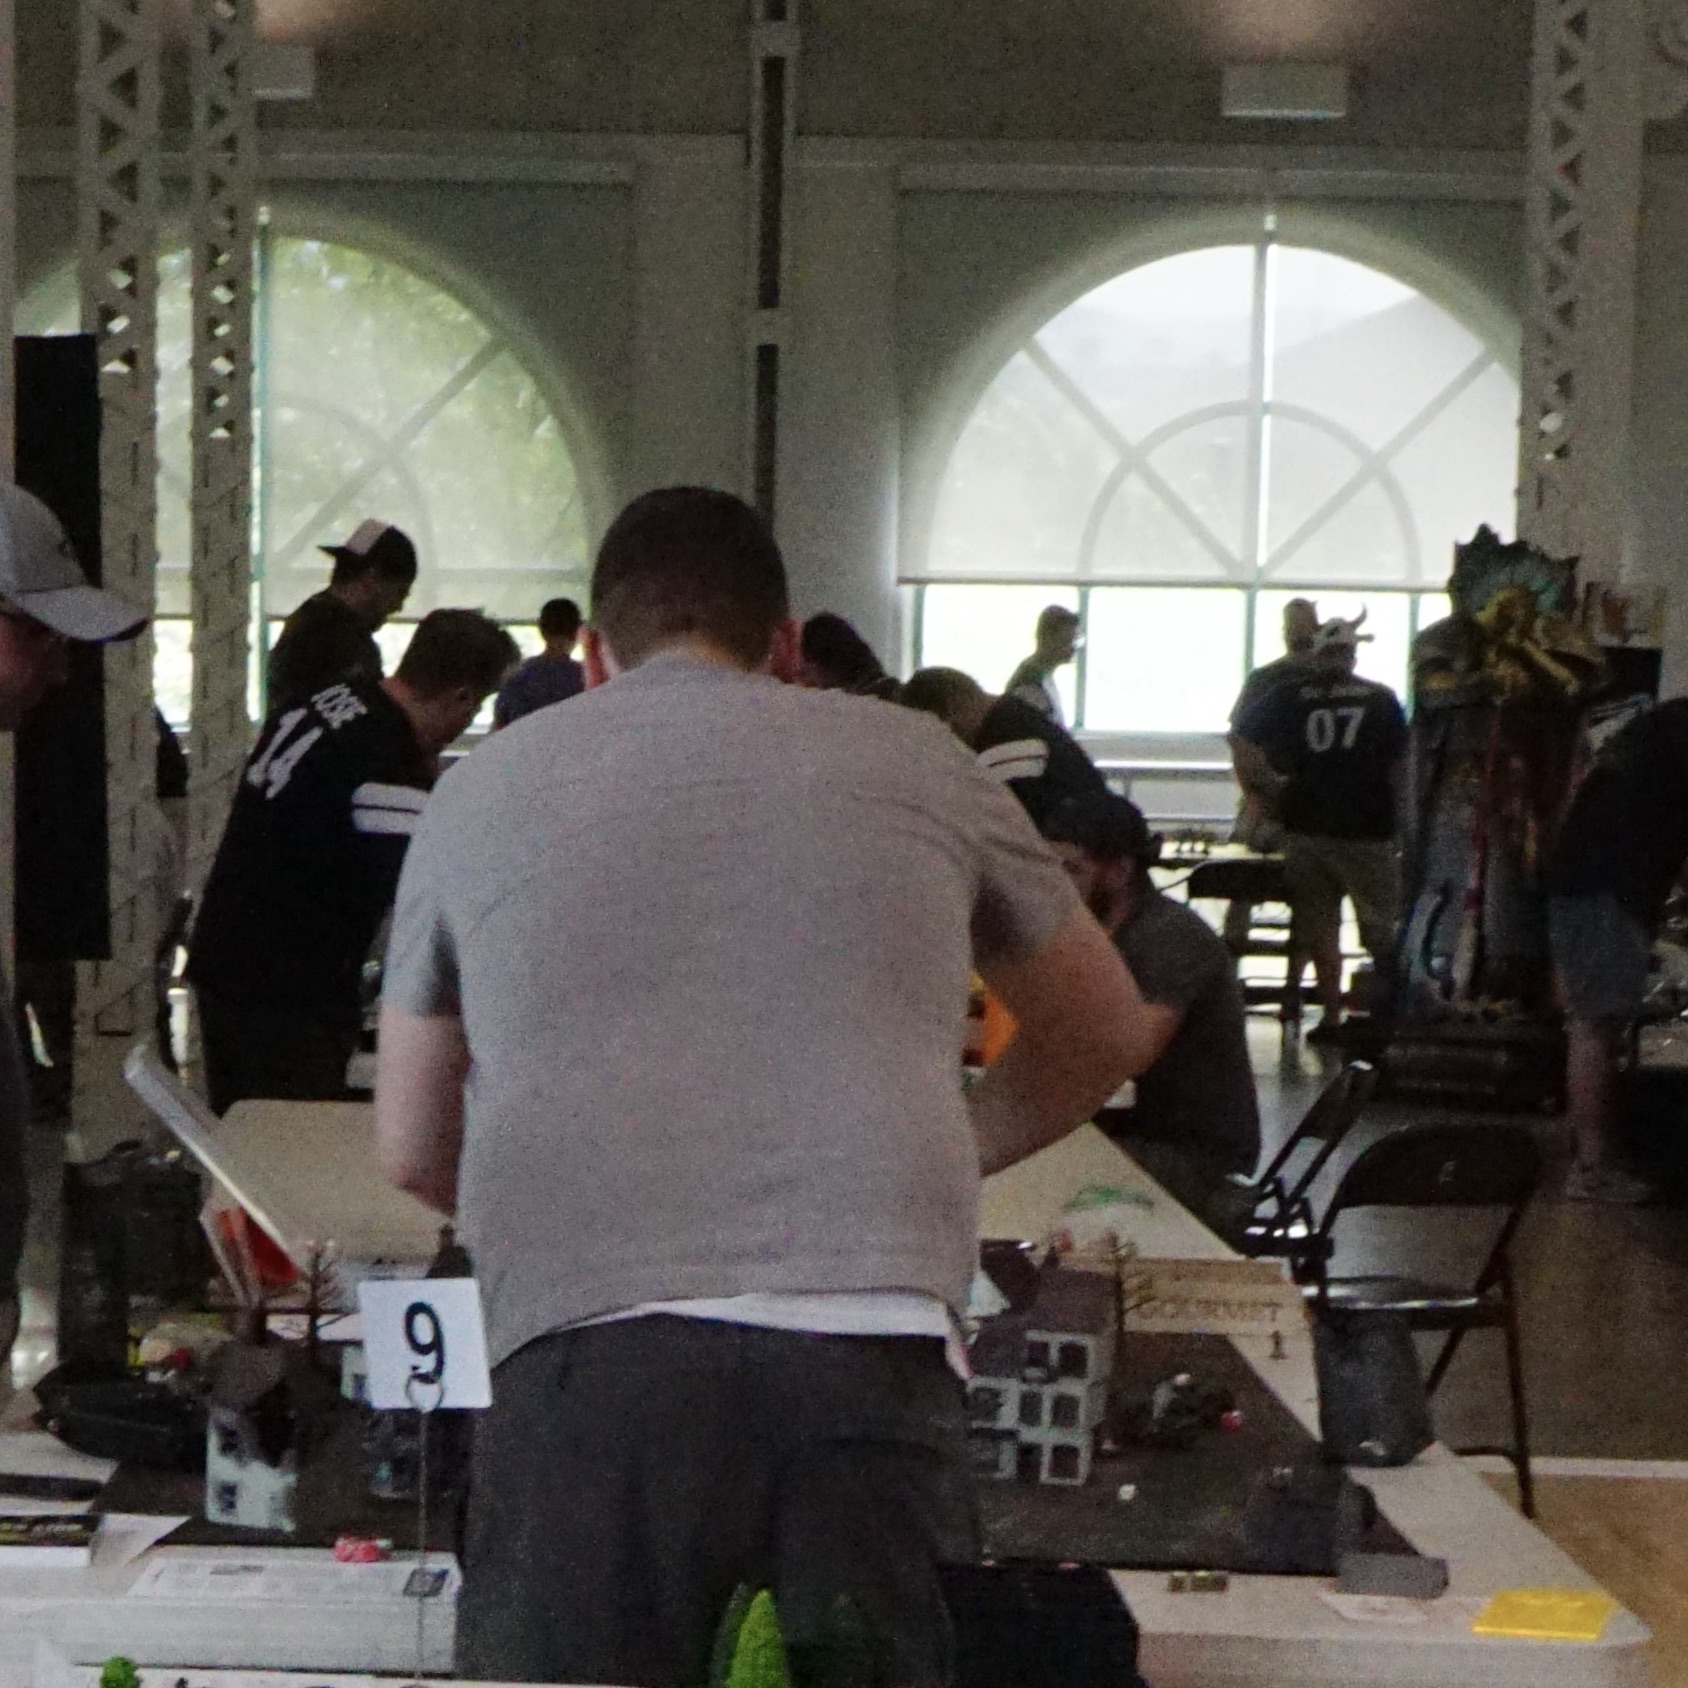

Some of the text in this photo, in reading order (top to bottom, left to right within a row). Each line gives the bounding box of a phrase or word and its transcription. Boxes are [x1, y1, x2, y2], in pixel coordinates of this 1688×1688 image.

[246, 706, 324, 800] 14
[1304, 705, 1367, 754] 07
[401, 1300, 446, 1385] 9
